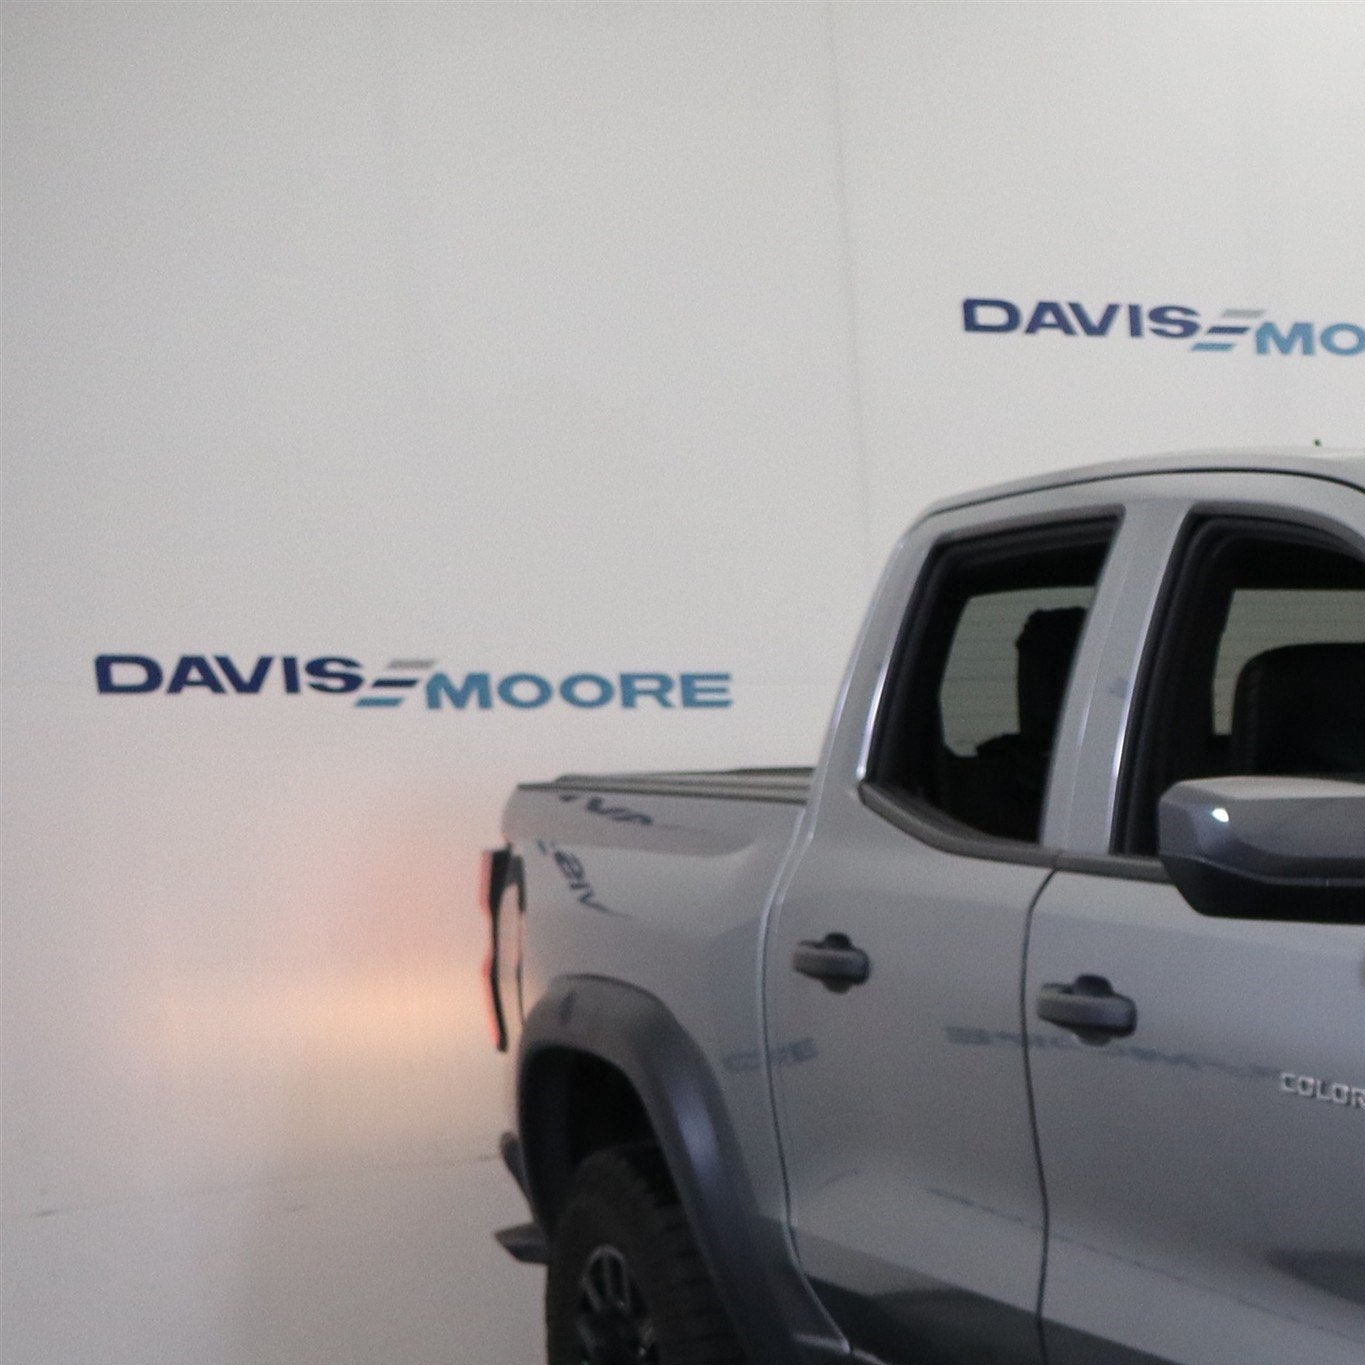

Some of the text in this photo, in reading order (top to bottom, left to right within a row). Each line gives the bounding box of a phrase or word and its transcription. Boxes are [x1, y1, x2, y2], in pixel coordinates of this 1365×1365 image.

[961, 297, 1202, 339] DAVIS
[94, 654, 734, 711] DAVIS MOORE
